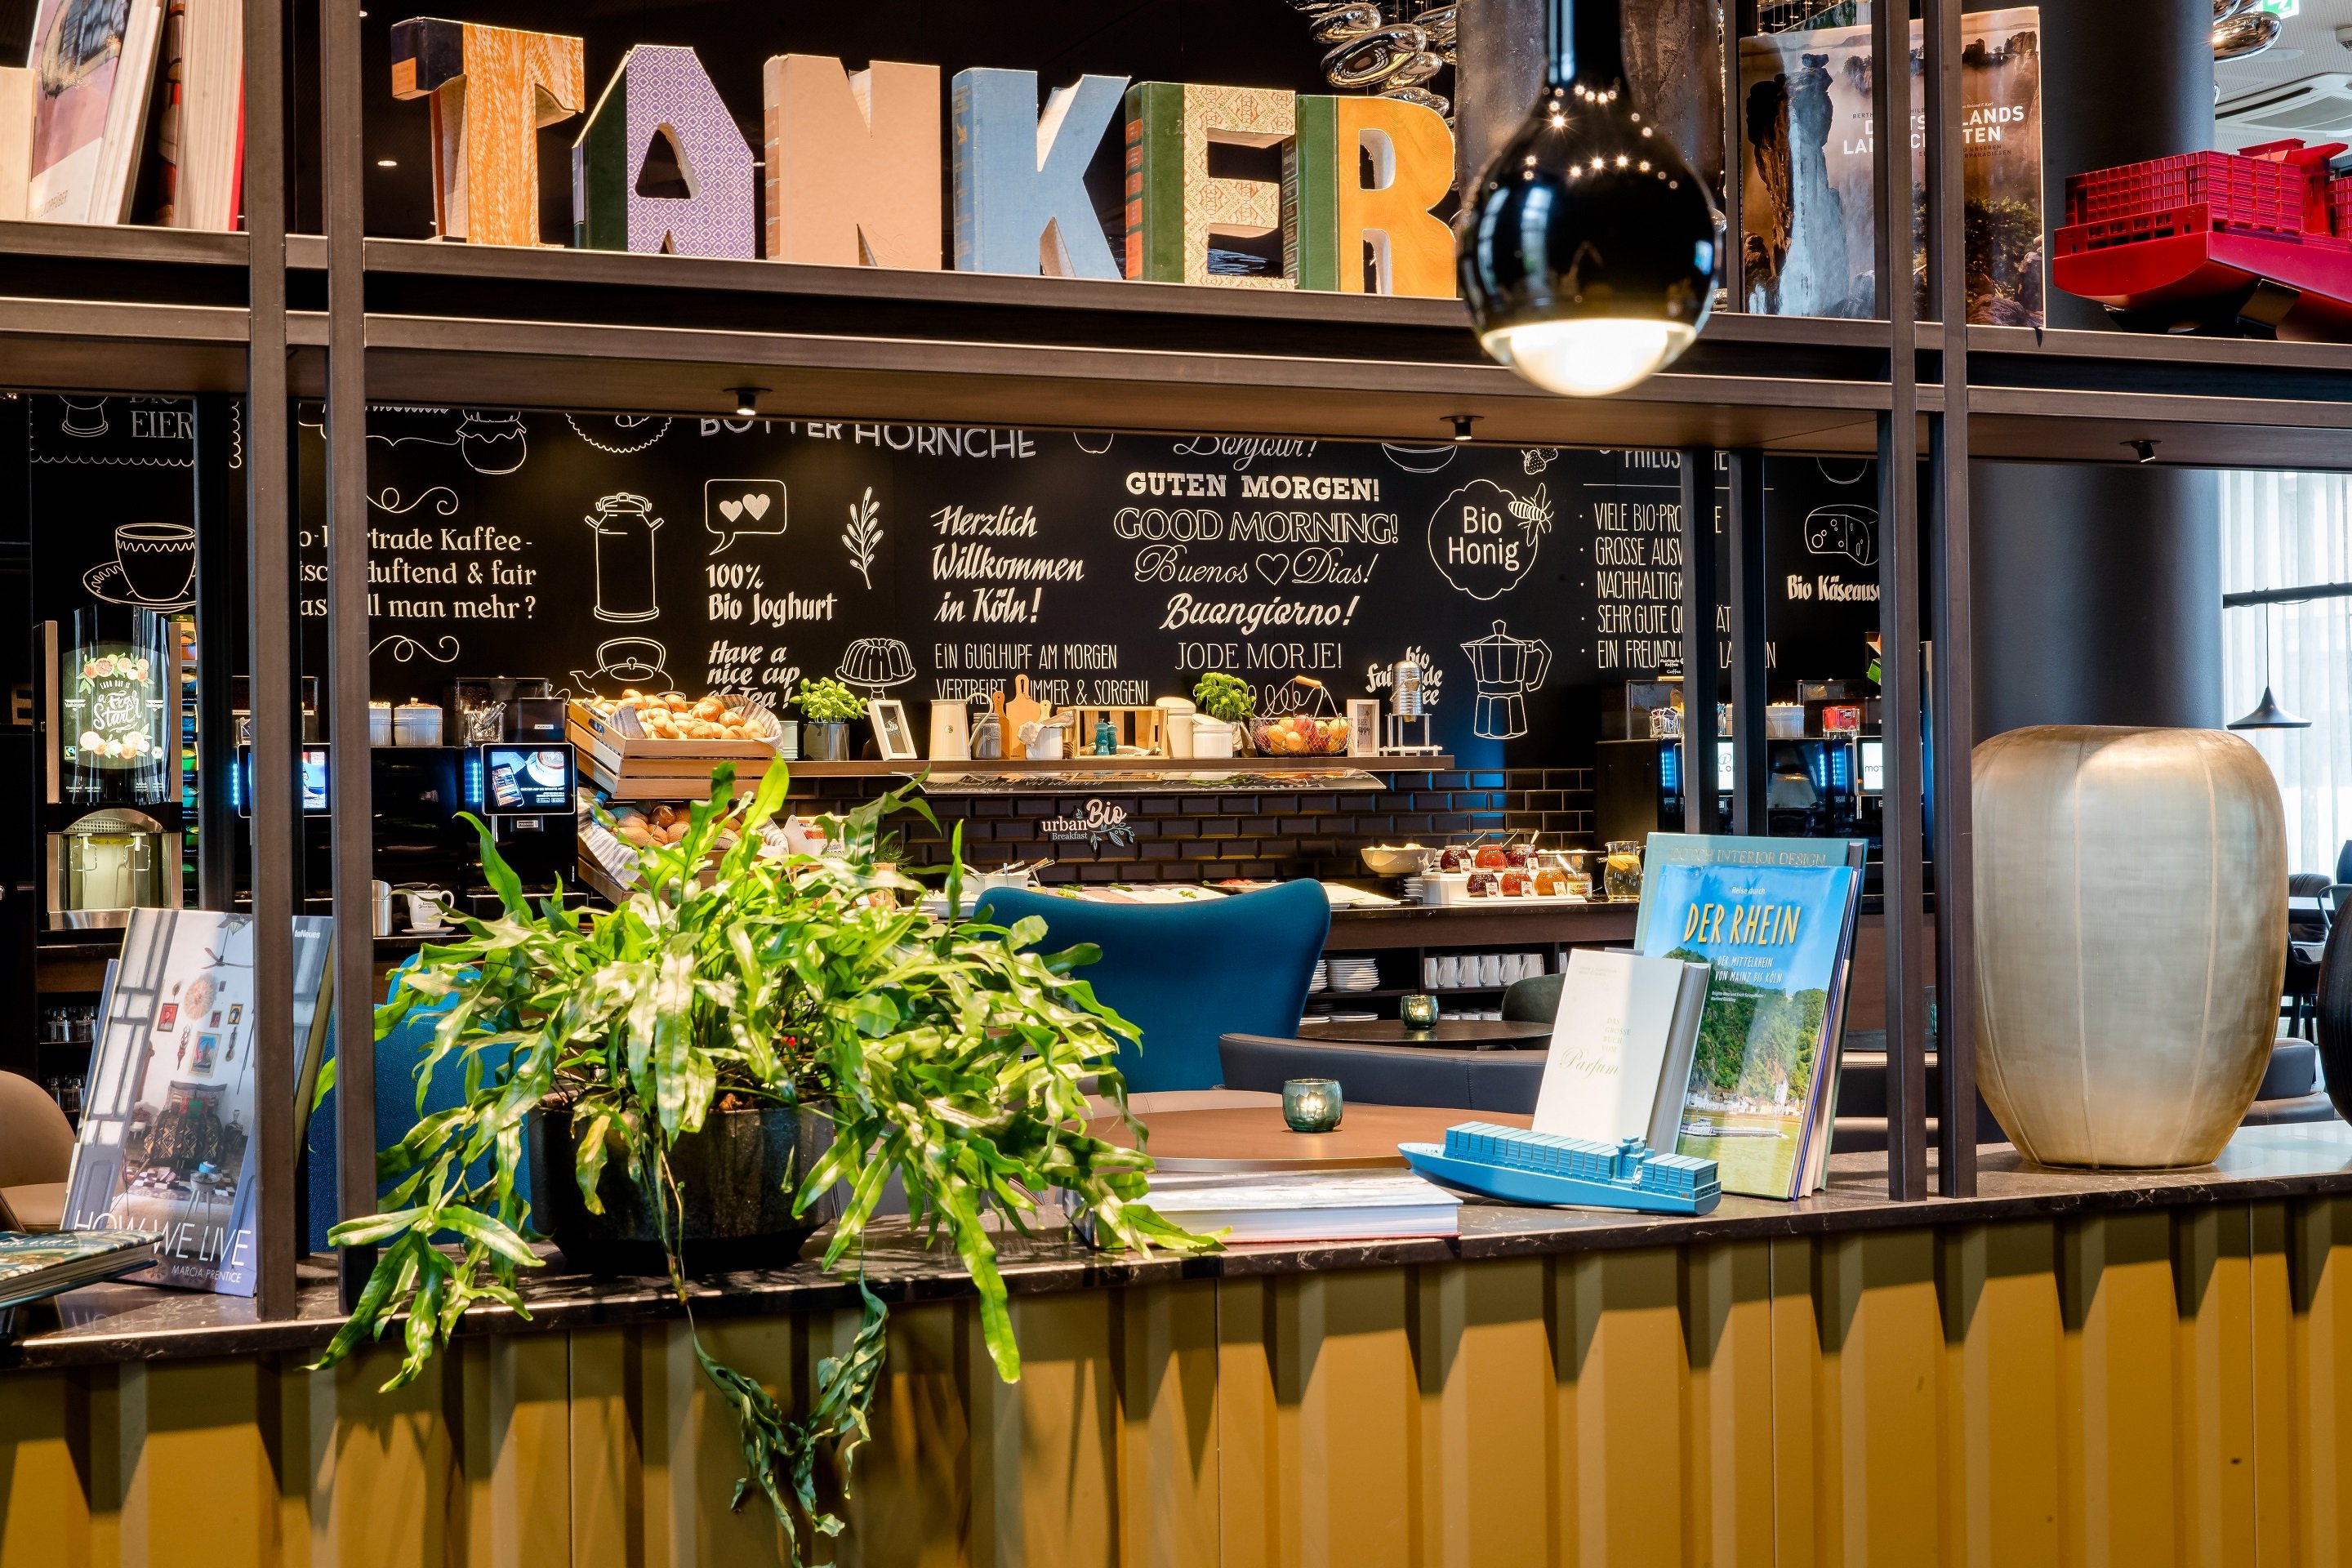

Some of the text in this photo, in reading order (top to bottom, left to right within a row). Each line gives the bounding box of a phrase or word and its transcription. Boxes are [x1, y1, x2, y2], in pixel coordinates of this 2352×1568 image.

[131, 411, 194, 439] EIER
[1125, 472, 1380, 501] GUTEN MORGEN!
[930, 505, 1038, 537] Herzlich
[1113, 507, 1399, 545] GOOD MORNING!
[1463, 506, 1502, 534] Bio
[1594, 503, 1628, 531] VIELE
[932, 541, 1085, 581] Willkommen
[1134, 544, 1379, 585] Buenos Dias!
[1448, 537, 1520, 572] Honig
[1595, 537, 1646, 566] GROSSE
[367, 557, 457, 584] duftend
[466, 562, 483, 585] &
[491, 559, 537, 586] fair
[705, 564, 764, 590] 100%
[1787, 574, 1812, 600] Bio
[388, 598, 447, 617] man
[708, 590, 838, 628] Bio Joghurt
[934, 586, 1043, 623] in Köln!
[1597, 604, 1632, 633] SEHR
[1634, 605, 1668, 634] GUTE
[708, 639, 787, 665] Have a
[964, 644, 1033, 670] GUGLHUPF
[1039, 644, 1058, 670] AM
[1064, 644, 1118, 670] MORGEN
[1174, 642, 1240, 670] JODE
[1405, 645, 1430, 670] bio
[1597, 639, 1619, 669] EIN
[706, 663, 800, 688] nice cup
[1076, 679, 1088, 706] &
[1094, 679, 1148, 706] SORGEN!
[93, 702, 136, 730] Start
[1041, 799, 1127, 832] urban Bio
[1052, 831, 1088, 840] Breakfast
[1717, 849, 1776, 865] INTERIOR
[1779, 852, 1826, 866] DESIGN
[1731, 886, 1766, 895] Reise durch
[1683, 902, 1802, 946] DER RHEIN
[1717, 955, 1774, 969] DER MITTELRHEIN
[1714, 970, 1784, 984] VON MAINZ BIS KÖLN
[1559, 1046, 1619, 1080] Parfum
[153, 1218, 196, 1259] WE
[198, 1225, 252, 1267] LIVE
[171, 1264, 243, 1284] MARCIA PRENTICE
